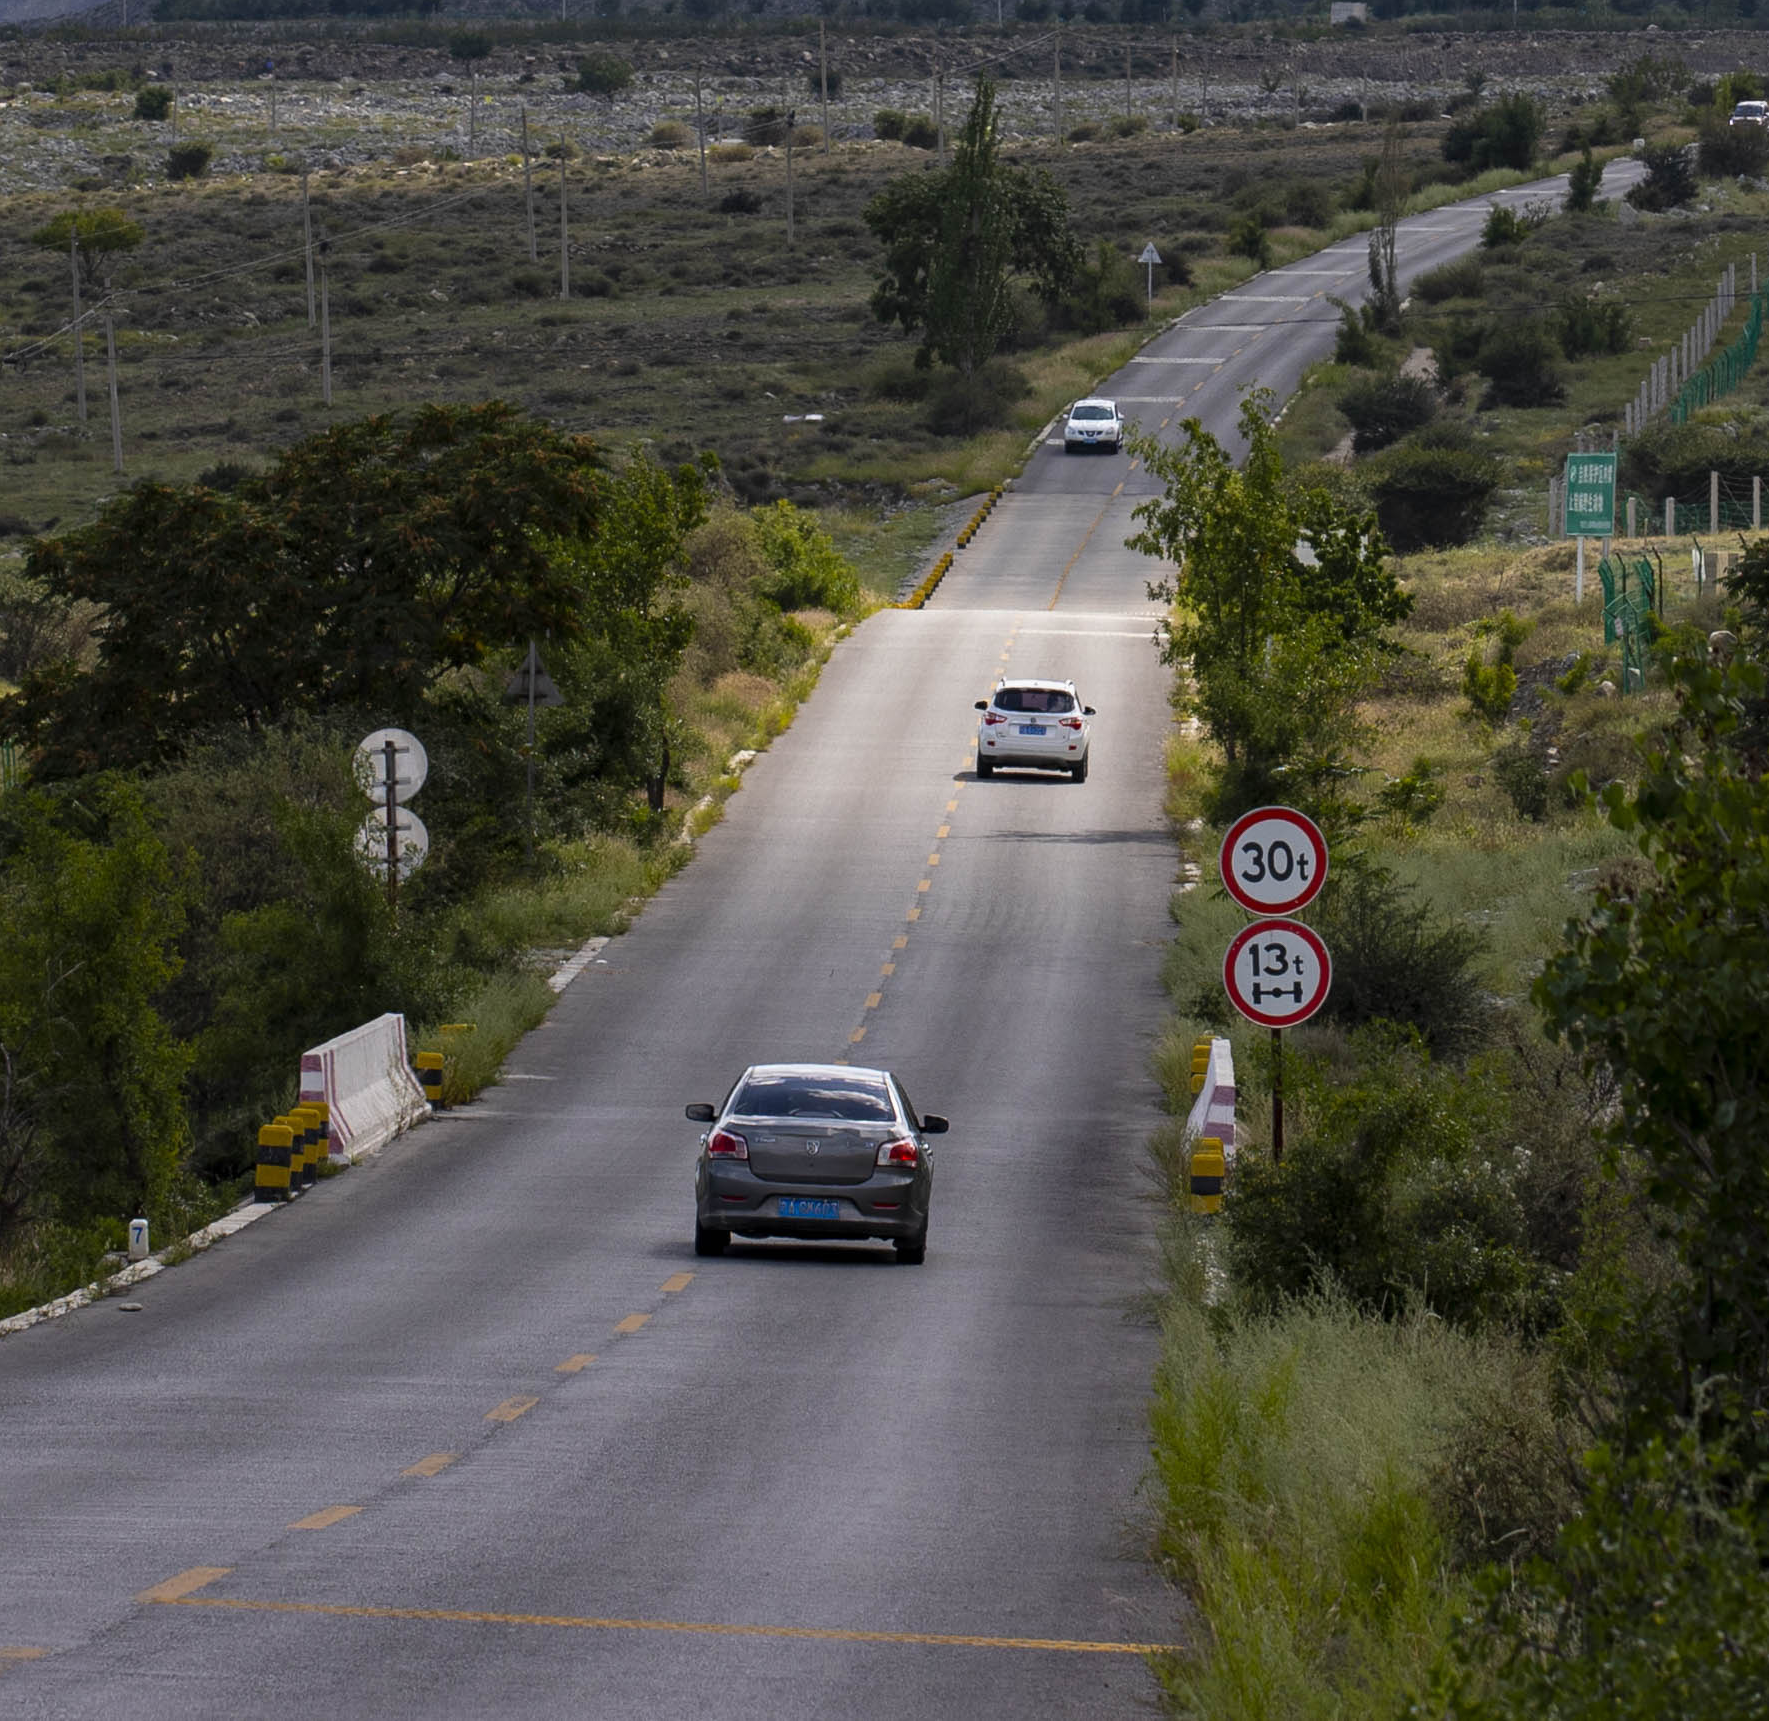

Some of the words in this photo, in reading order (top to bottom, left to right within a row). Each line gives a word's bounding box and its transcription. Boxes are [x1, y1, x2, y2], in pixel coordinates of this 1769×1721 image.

[1241, 840, 1309, 883] 30t
[1248, 942, 1304, 977] 13t
[131, 1226, 144, 1244] 7
